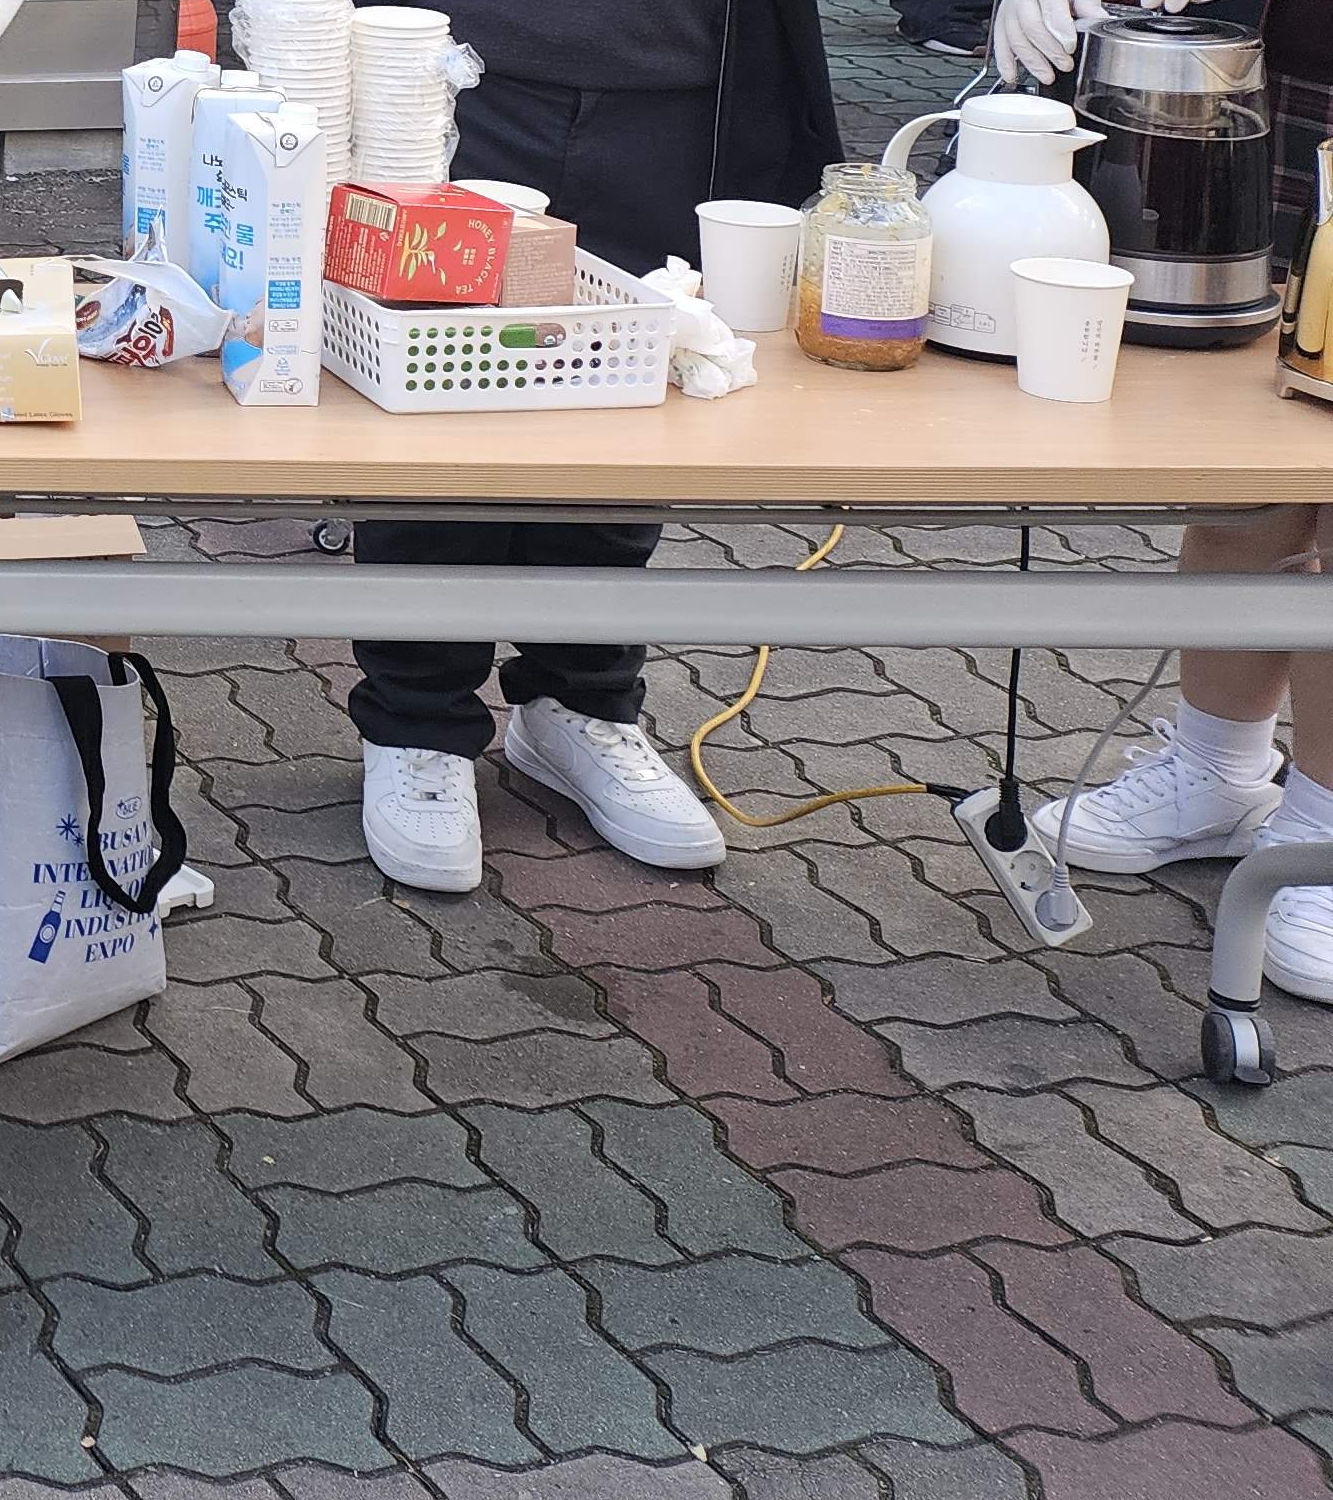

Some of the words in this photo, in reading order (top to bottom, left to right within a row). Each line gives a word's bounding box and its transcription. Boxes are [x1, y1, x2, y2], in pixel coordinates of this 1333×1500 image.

[468, 219, 495, 243] HONEY
[476, 248, 496, 286] BLACK
[456, 283, 473, 294] TEA
[85, 933, 134, 963] EXPO
